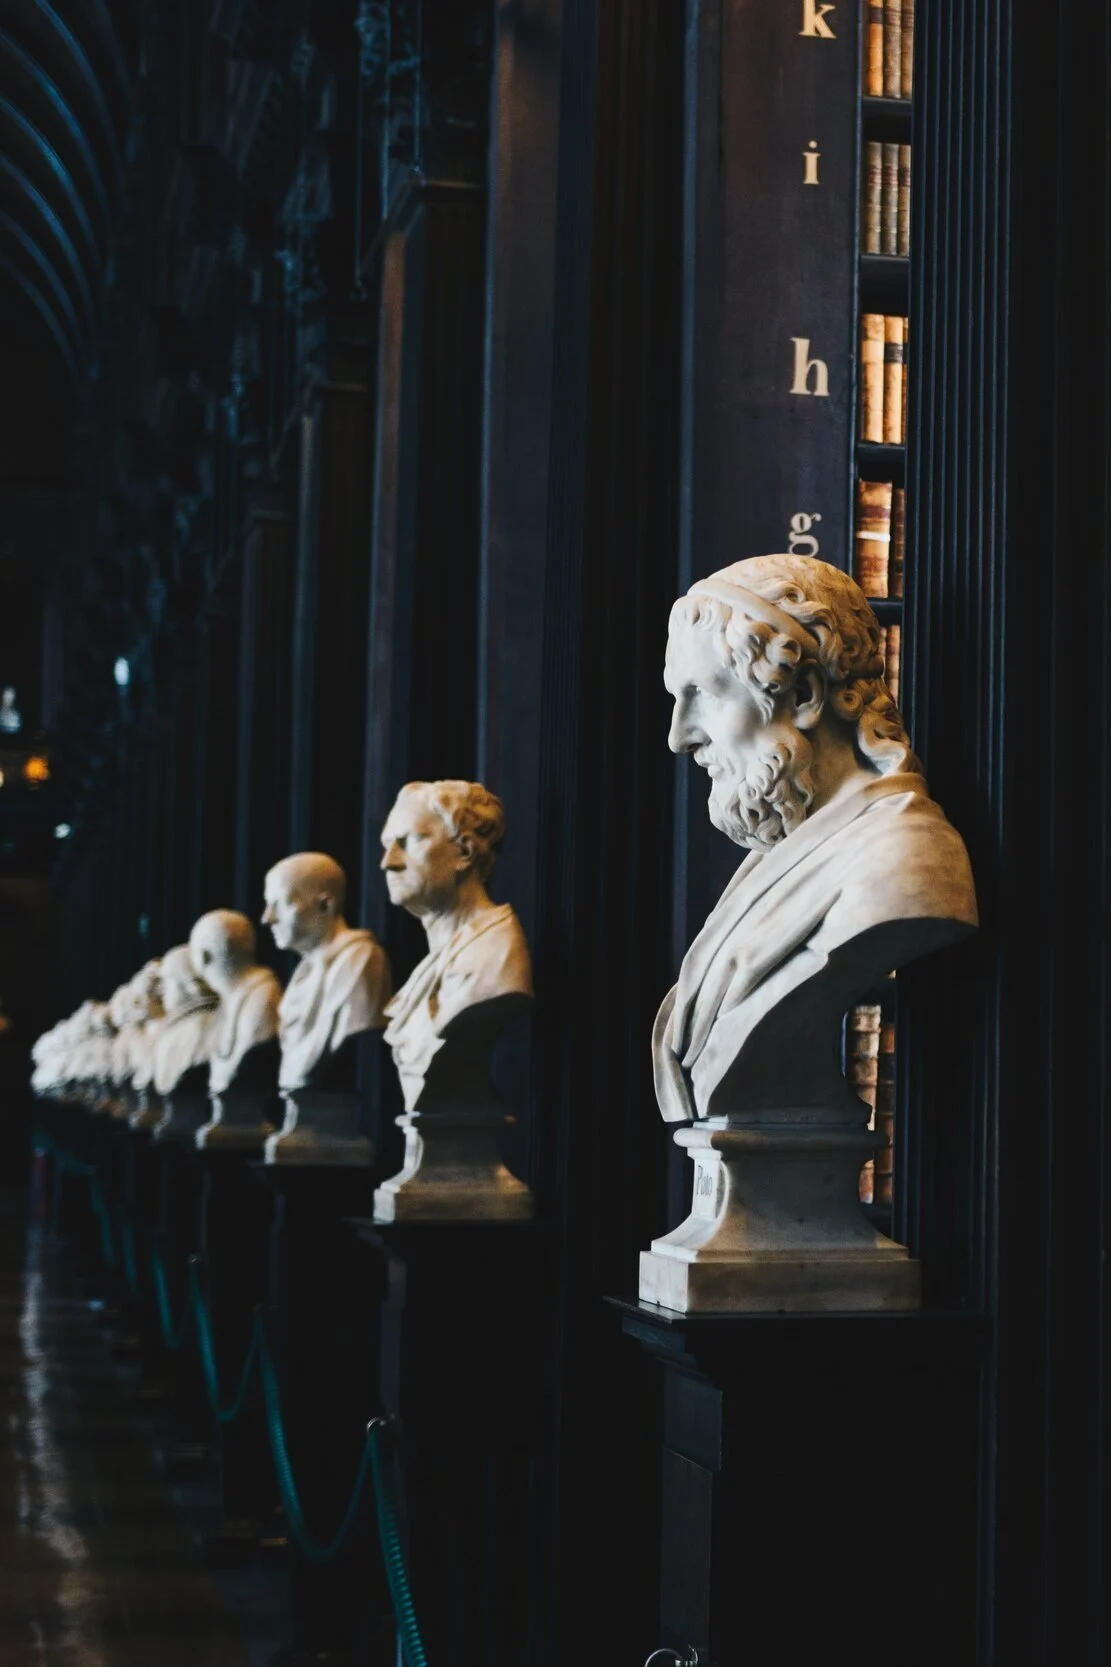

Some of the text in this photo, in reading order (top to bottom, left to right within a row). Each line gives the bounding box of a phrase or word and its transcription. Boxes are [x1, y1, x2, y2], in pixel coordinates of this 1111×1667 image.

[798, 0, 837, 39] k
[802, 140, 821, 185] i
[788, 336, 830, 397] h
[786, 512, 822, 558] g
[695, 1163, 714, 1197] Plato
